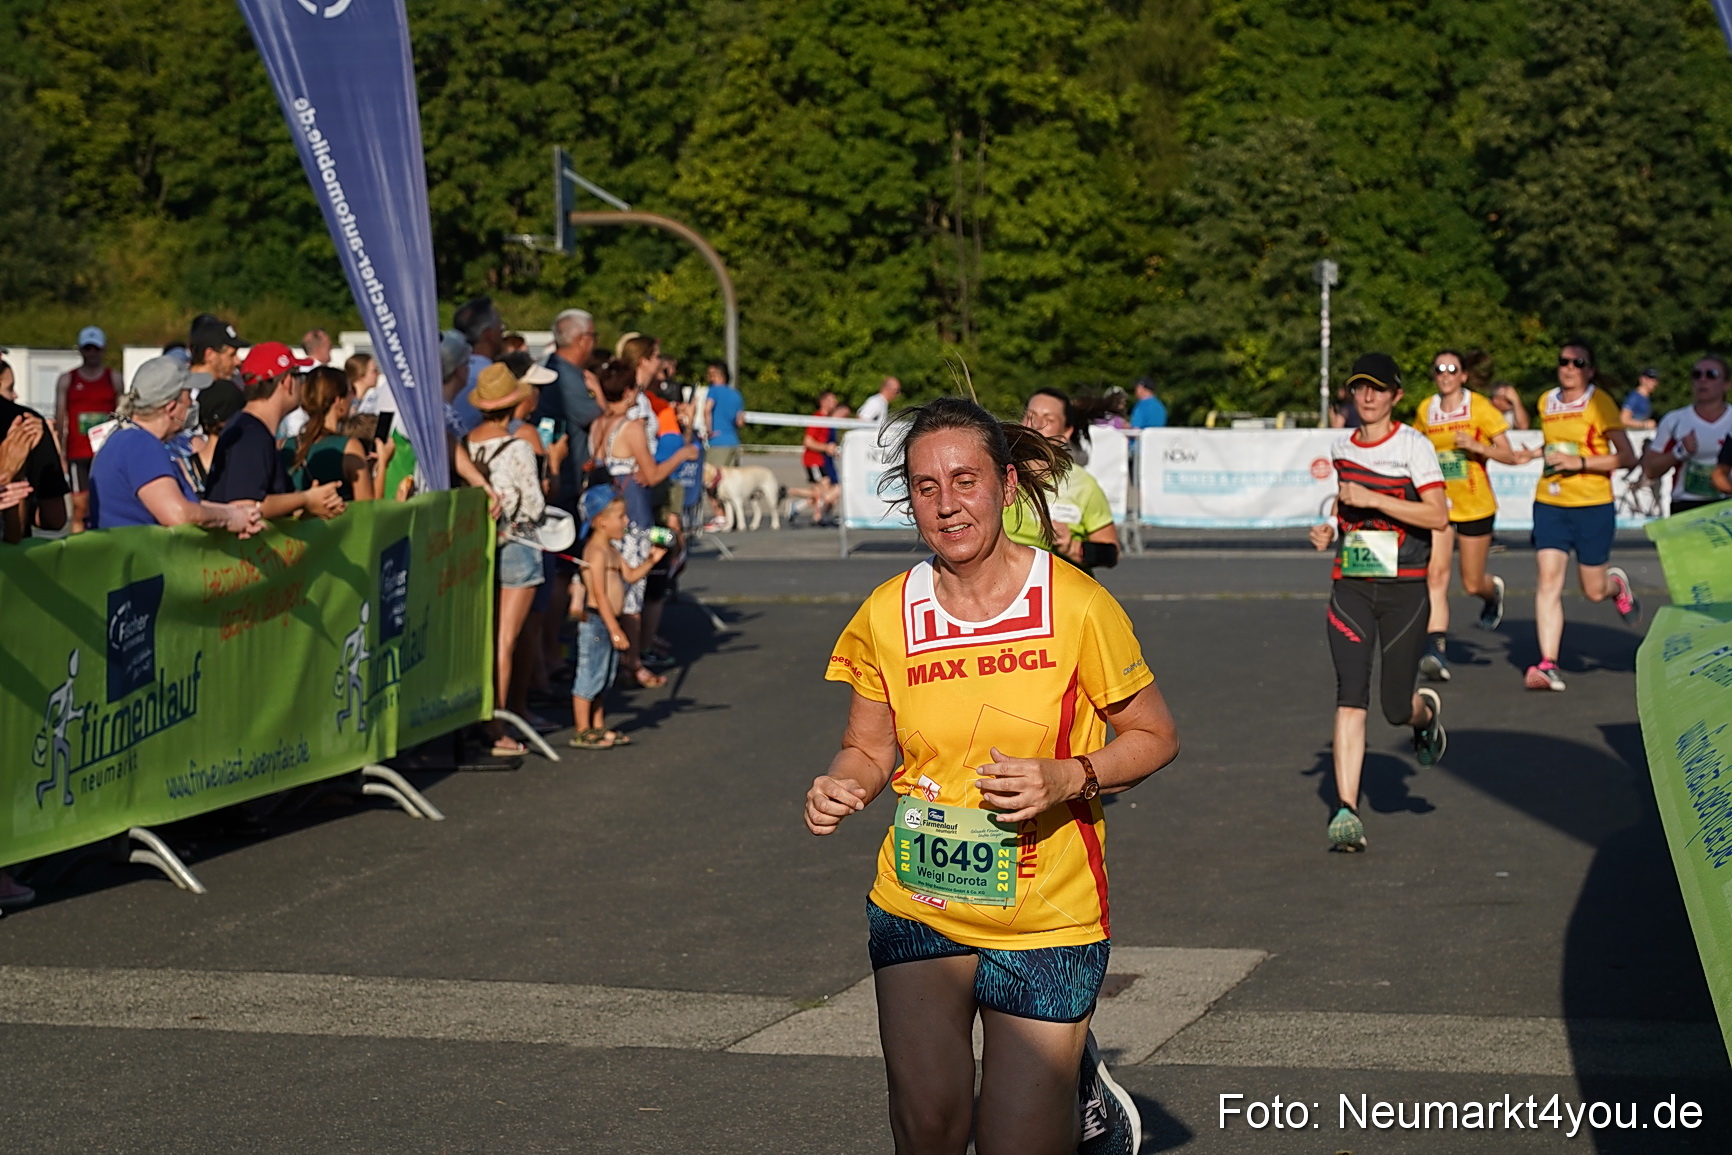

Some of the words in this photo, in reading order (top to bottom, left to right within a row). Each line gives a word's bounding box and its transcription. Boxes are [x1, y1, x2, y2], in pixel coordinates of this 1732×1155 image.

[907, 659, 969, 687] MAX
[977, 647, 1057, 676] BÖGL
[80, 752, 139, 794] neumarkt
[922, 819, 958, 831] Firmenlauf
[900, 839, 910, 872] RUN
[913, 833, 994, 873] 1649
[997, 848, 1010, 892] 2022
[917, 866, 945, 883] Weigl
[948, 873, 987, 887] Dorota
